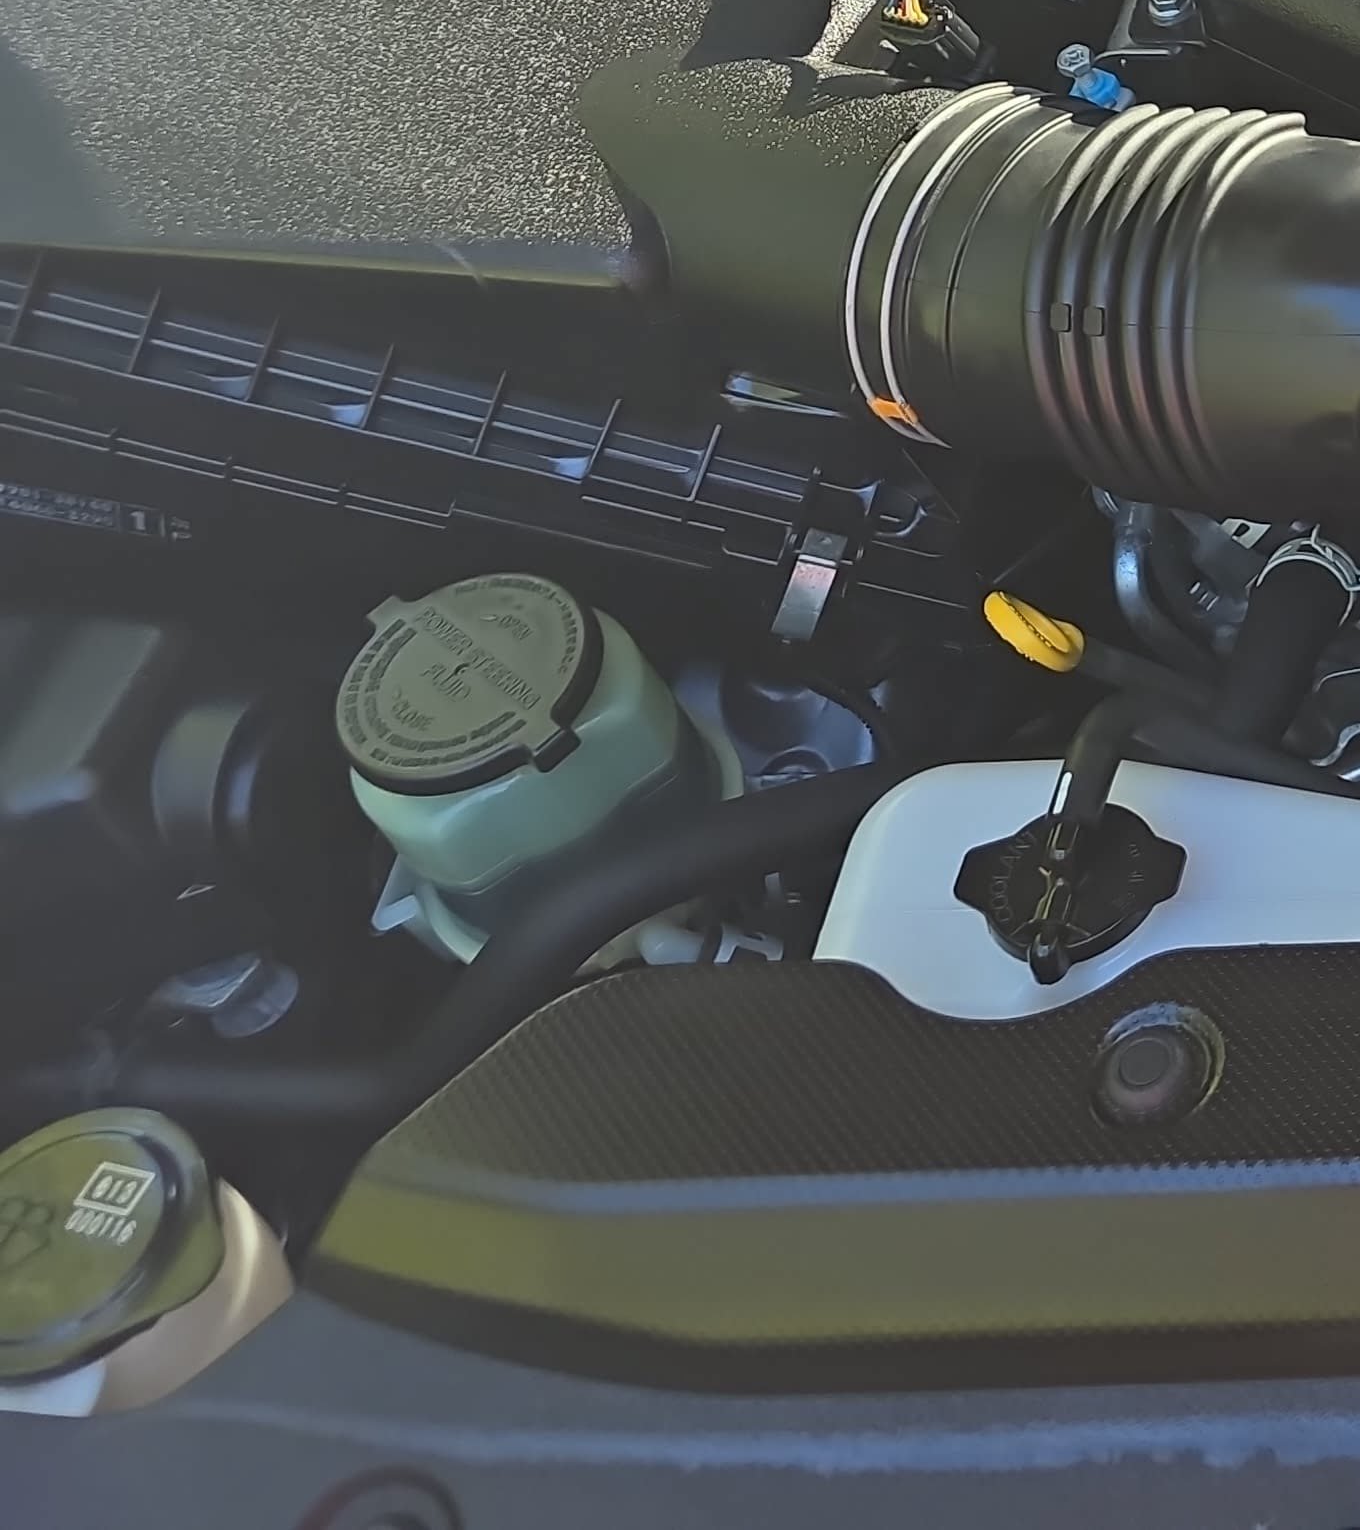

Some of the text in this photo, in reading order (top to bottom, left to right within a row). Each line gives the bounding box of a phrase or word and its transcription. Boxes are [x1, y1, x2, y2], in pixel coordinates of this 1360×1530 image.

[129, 510, 147, 531] 1
[415, 606, 474, 656] POWER
[468, 645, 542, 711] STEERING
[420, 661, 472, 702] FLUID
